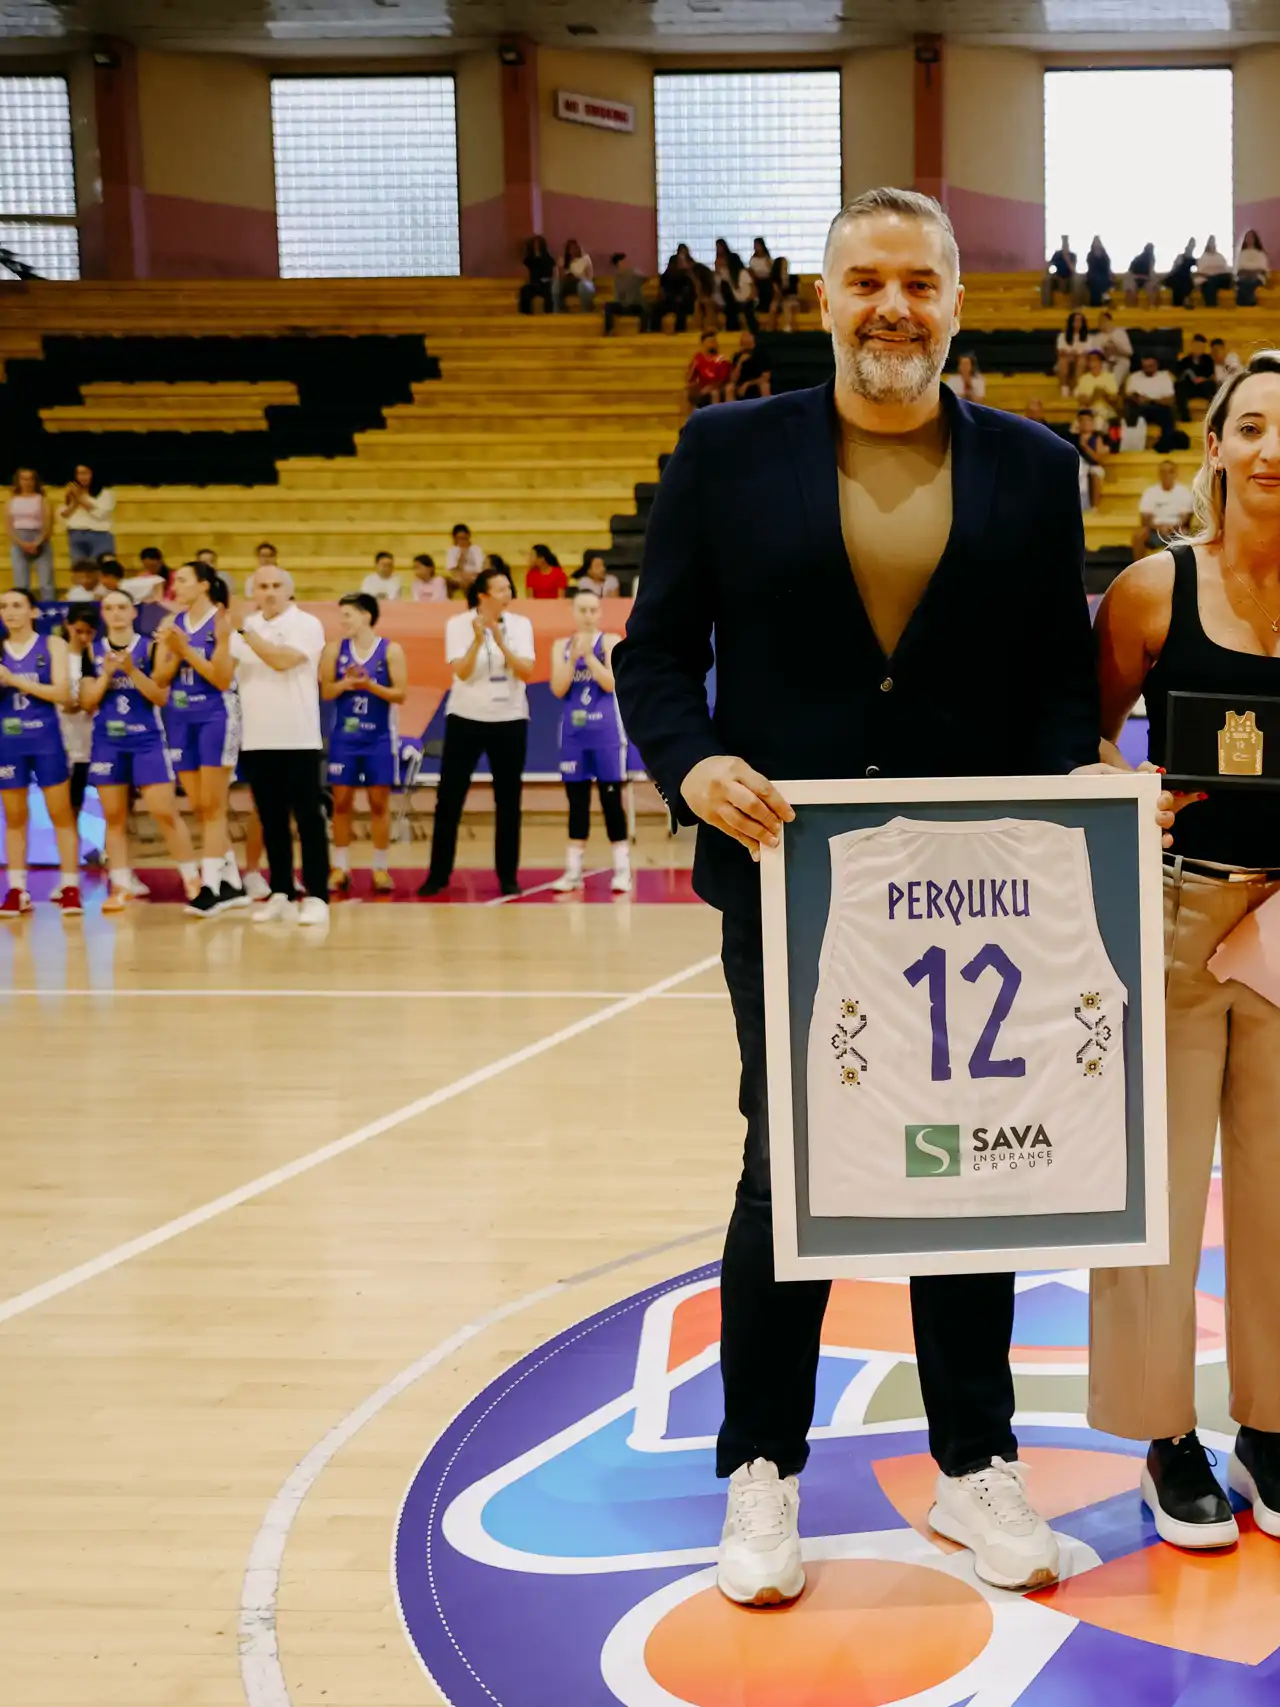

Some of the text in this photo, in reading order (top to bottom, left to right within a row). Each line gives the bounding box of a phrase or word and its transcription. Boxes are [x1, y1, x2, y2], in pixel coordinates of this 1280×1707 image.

[117, 695, 131, 714] 8
[581, 687, 592, 706] 6
[888, 879, 1030, 926] PERQUKU
[903, 943, 1026, 1082] 12
[972, 1123, 1053, 1152] SAVA
[973, 1150, 1053, 1162] INSURANCE
[973, 1159, 1053, 1171] GROUP
